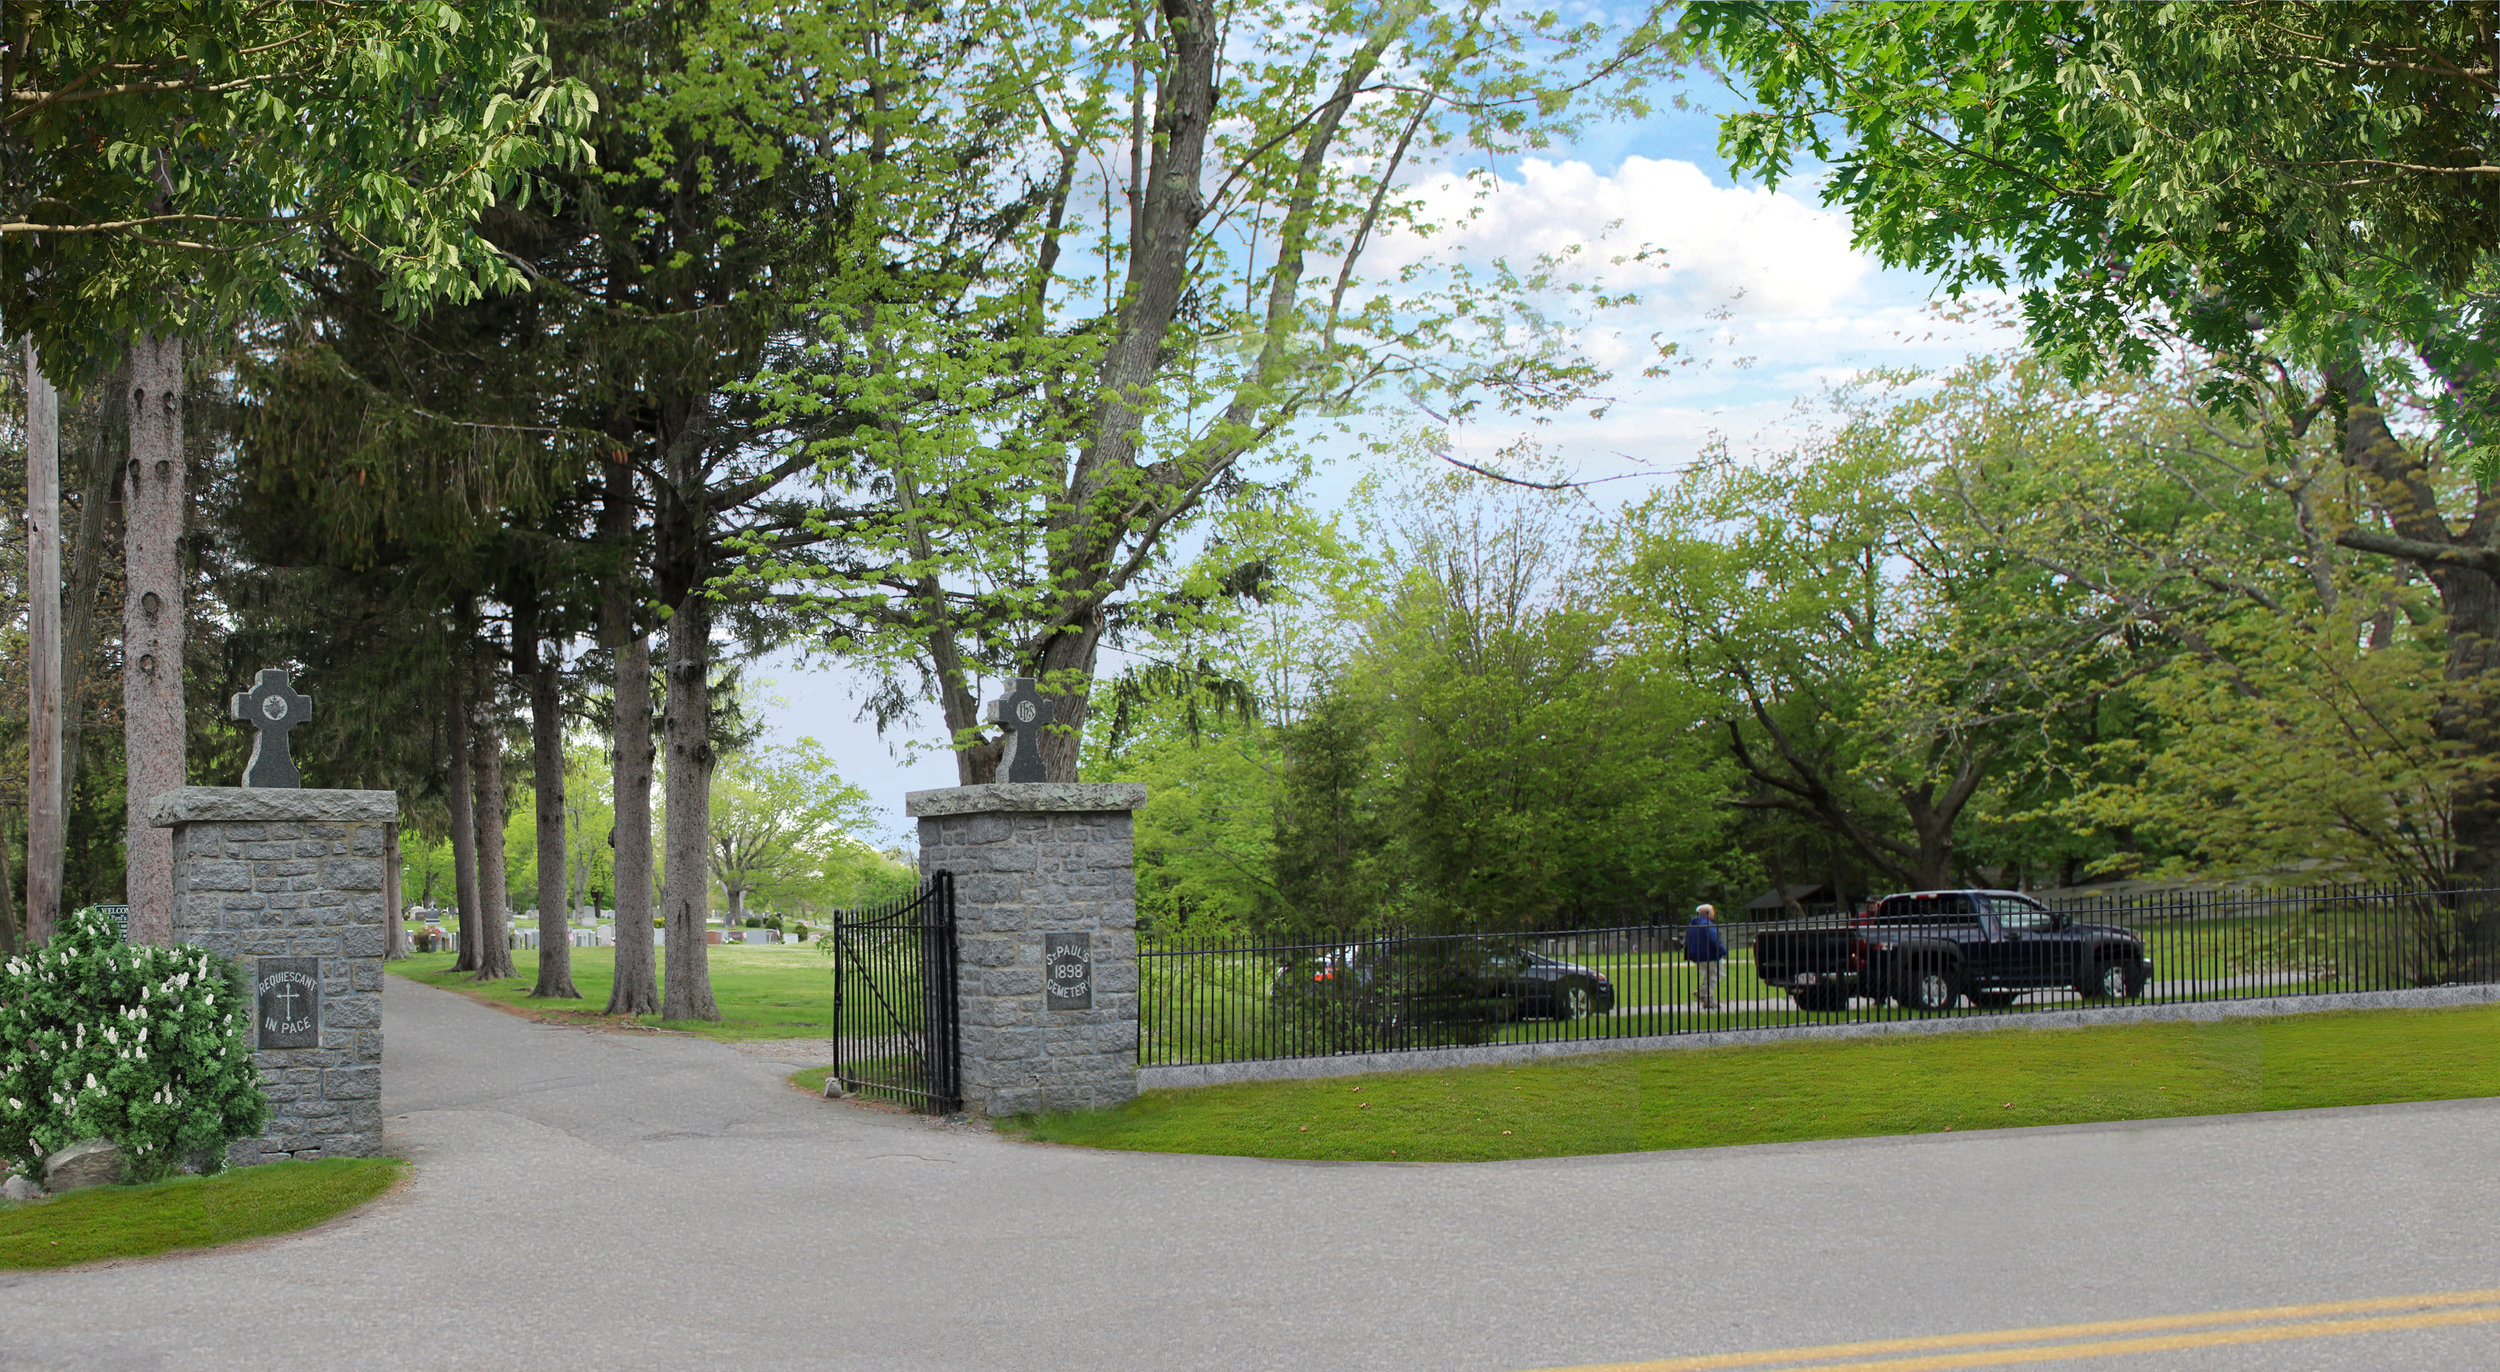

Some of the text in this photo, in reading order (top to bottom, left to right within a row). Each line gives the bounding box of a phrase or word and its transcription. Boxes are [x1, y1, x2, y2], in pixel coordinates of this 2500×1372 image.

[1056, 944, 1090, 963] PAUL'S
[1055, 964, 1083, 979] 1898
[258, 971, 318, 997] REQUIESCANT
[1047, 975, 1091, 999] CEMETERY
[265, 1016, 312, 1034] IN PACE
